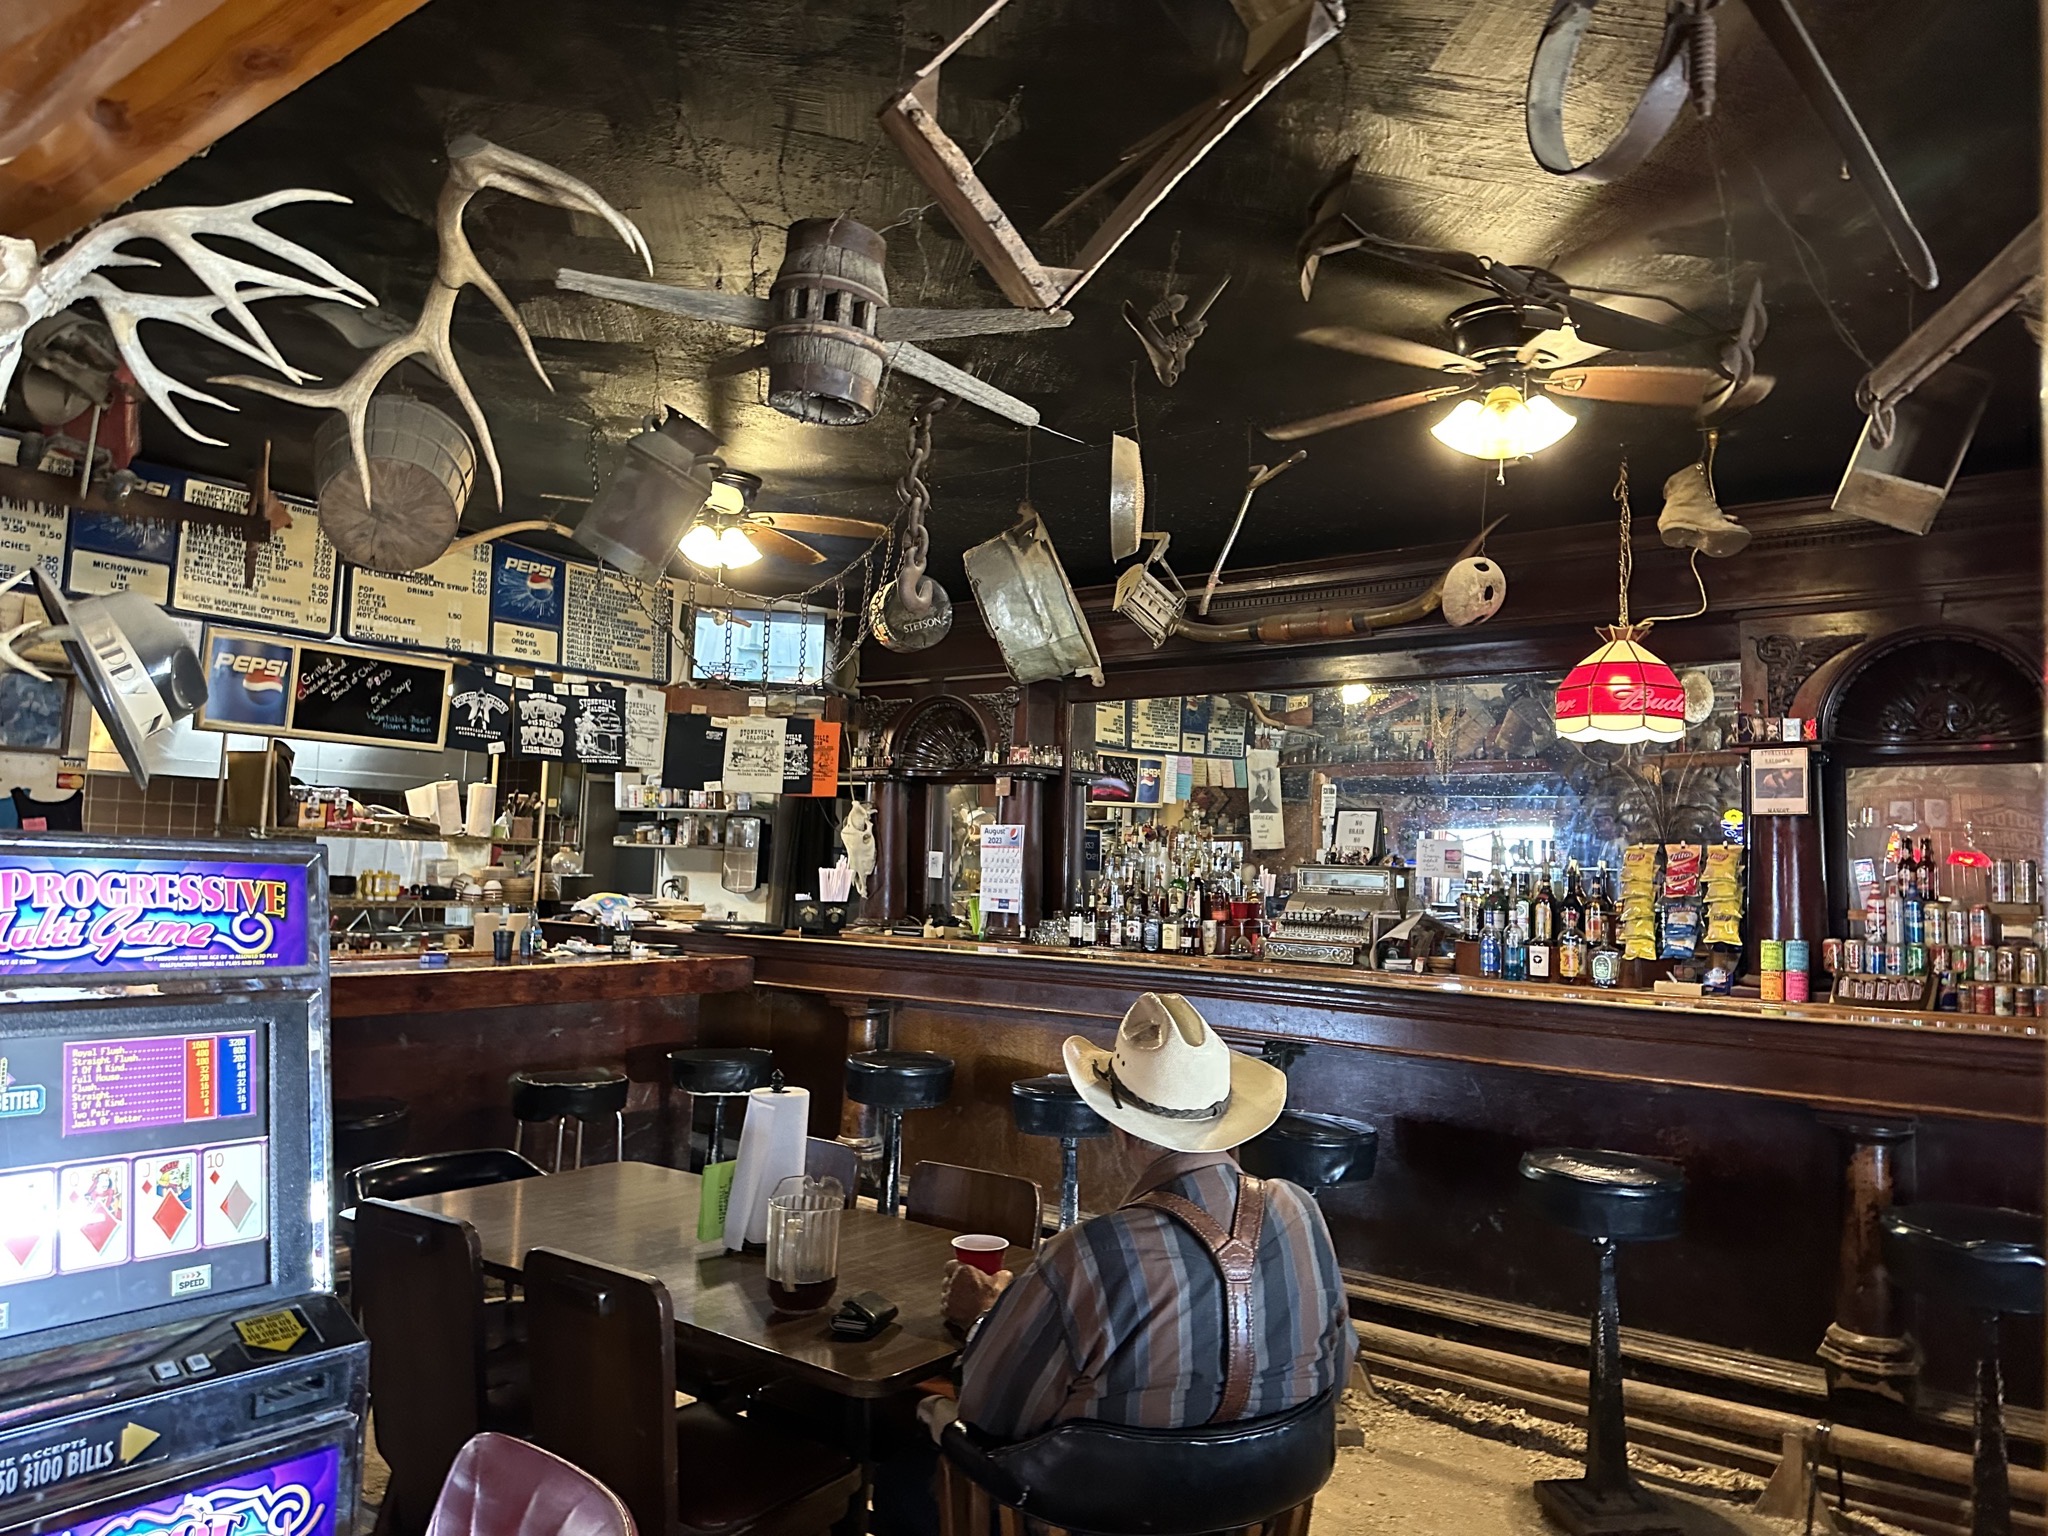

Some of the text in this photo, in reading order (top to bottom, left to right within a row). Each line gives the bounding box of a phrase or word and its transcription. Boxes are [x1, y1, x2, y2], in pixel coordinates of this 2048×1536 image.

[219, 537, 242, 548] CORN
[92, 560, 149, 578] MICROWAVE
[217, 563, 243, 575] TACOS
[275, 563, 290, 572] DIP
[505, 557, 556, 579] PEPSI
[116, 573, 127, 582] IN
[405, 576, 445, 589] CHOCOLATE
[447, 583, 469, 593] SYRUP
[110, 582, 130, 591] USE
[358, 585, 374, 593] POP
[407, 586, 434, 597] DRINKS
[357, 592, 386, 601] COFFEE
[260, 607, 295, 619] OYSTERS
[306, 615, 326, 624] 11.00
[357, 605, 379, 614] JUICE
[358, 598, 462, 620] ICE TEA 1.50
[356, 612, 416, 626] HOT CHOCOLATE
[903, 616, 942, 634] STETSON
[355, 624, 374, 632] MILK
[525, 631, 535, 639] GO
[354, 630, 420, 645] CHOCOLATE MILK
[511, 638, 537, 648] ORDERS
[213, 652, 288, 678] PEPSI
[301, 657, 334, 685] Grilled
[331, 681, 352, 702] Bowl
[391, 678, 411, 700] Soup
[370, 692, 381, 704] or
[578, 698, 617, 712] STONEVILLE
[410, 723, 431, 733] Bean
[739, 729, 775, 739] STONEVILLE
[62, 760, 82, 768] VISA
[984, 827, 1006, 836] August
[0, 868, 287, 918] PROGRESSIVE
[90, 906, 216, 963] Game
[72, 1048, 97, 1058] Royal
[72, 1056, 111, 1067] Straight
[105, 1063, 125, 1073] Kind
[72, 1065, 209, 1084] Full House 32
[72, 1083, 98, 1093] Flush
[72, 1091, 111, 1102] Straight
[237, 1078, 246, 1087] 32
[0, 1089, 39, 1112] ETTER
[72, 1102, 78, 1110] 3
[105, 1098, 125, 1107] Kind
[200, 1090, 209, 1098] 12
[237, 1086, 246, 1095] 24
[72, 1110, 88, 1119] Two
[90, 1108, 110, 1118] Pair
[72, 1119, 97, 1129] Jacks
[114, 1114, 142, 1124] Better
[204, 1107, 209, 1115] 4
[207, 1152, 225, 1169] 10
[69, 1171, 80, 1188] Q
[178, 1277, 205, 1290] SPEED
[20, 1437, 87, 1464] ACCEPTS
[23, 1455, 63, 1490] $100
[66, 1440, 114, 1478] BILLS
